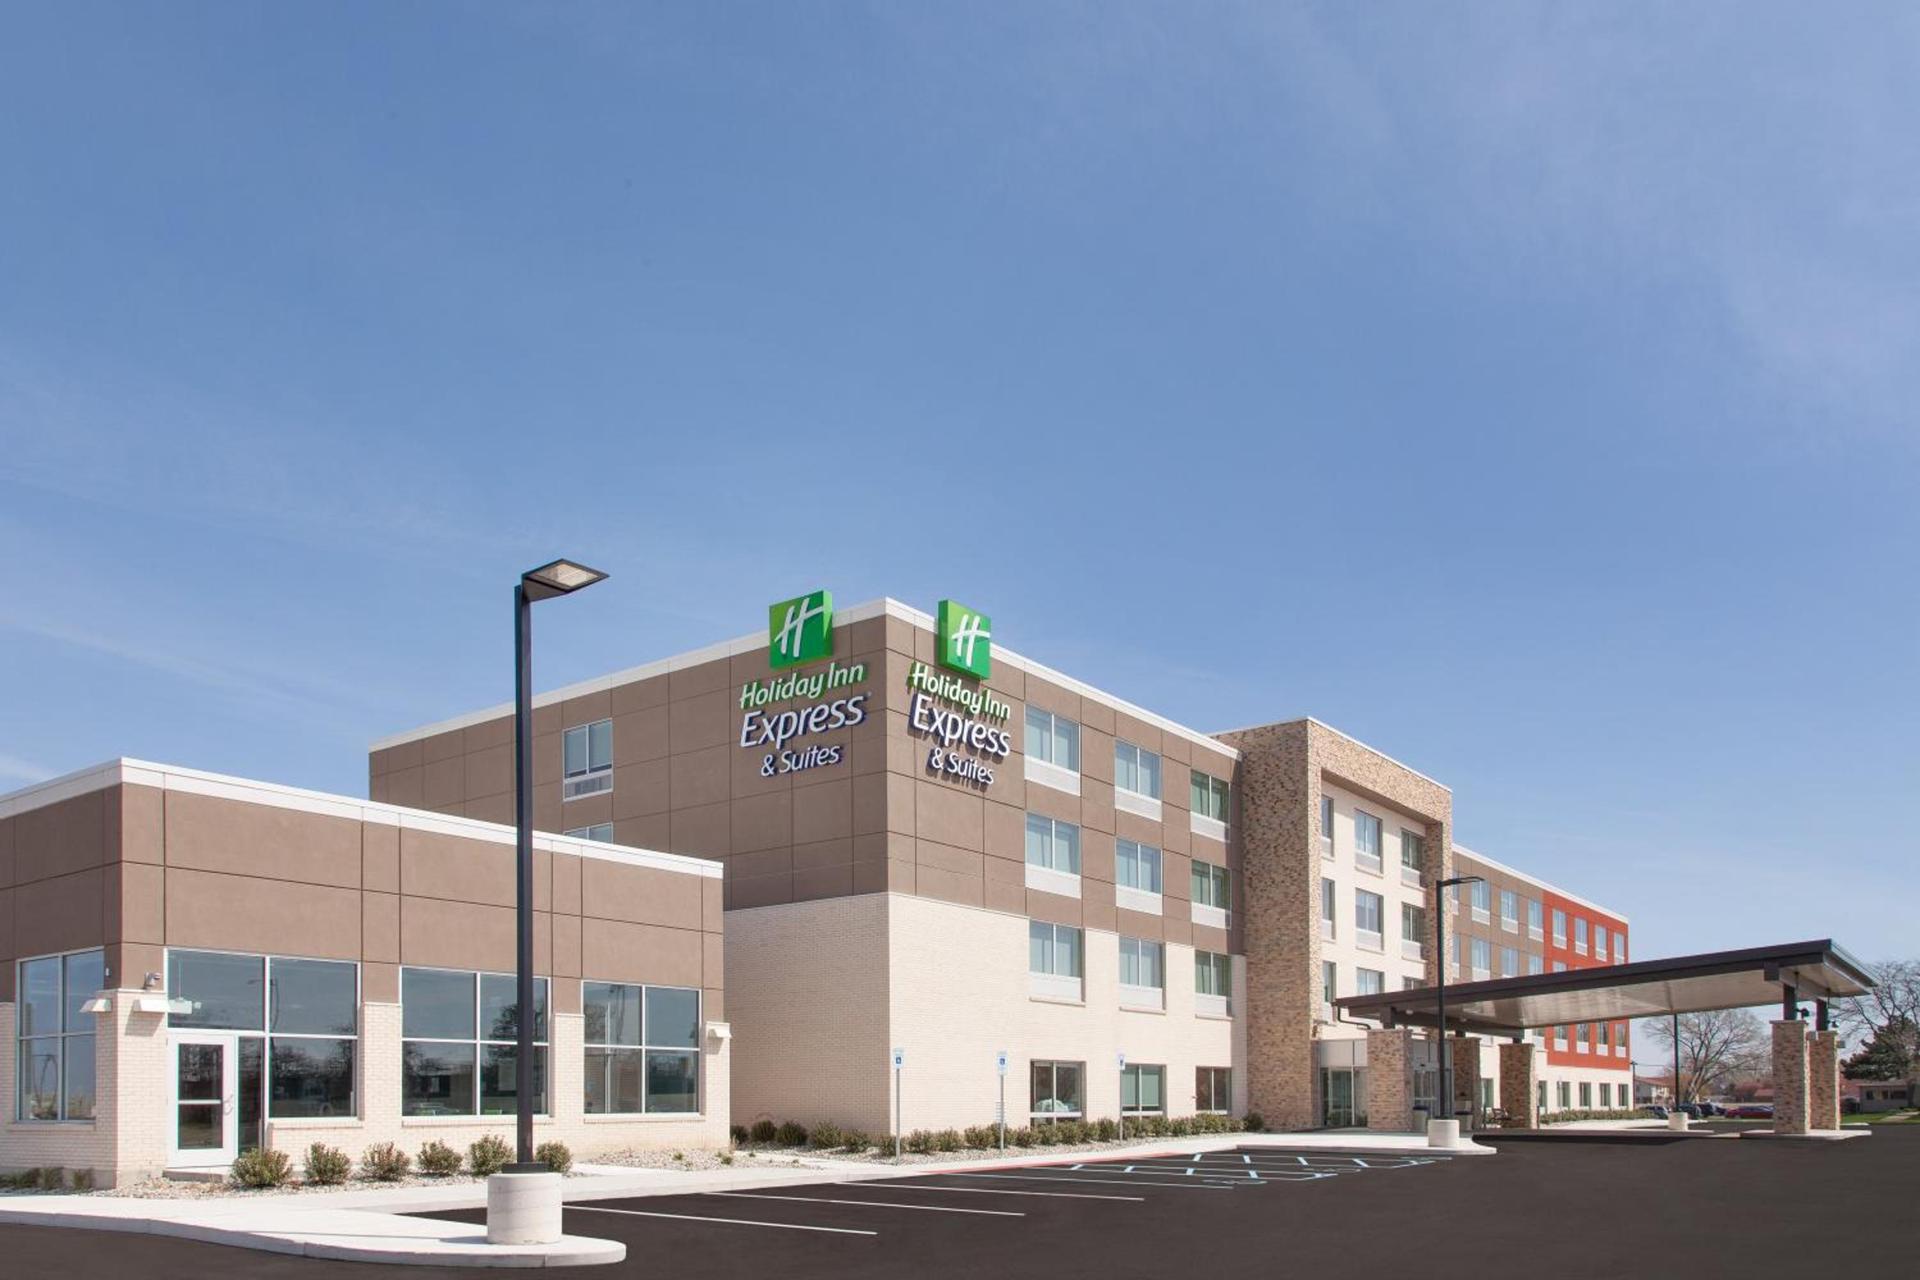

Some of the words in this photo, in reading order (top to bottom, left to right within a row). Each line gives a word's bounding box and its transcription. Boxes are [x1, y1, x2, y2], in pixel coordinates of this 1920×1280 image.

[740, 672, 824, 709] Holiday
[827, 662, 864, 689] Inn
[912, 662, 983, 714] Holiday
[984, 689, 1011, 720] Inn
[740, 695, 864, 750] Express
[913, 693, 1011, 757] Express
[760, 754, 775, 777] &
[779, 745, 840, 773] Suites
[931, 747, 944, 770] &
[947, 752, 994, 785] Suites
